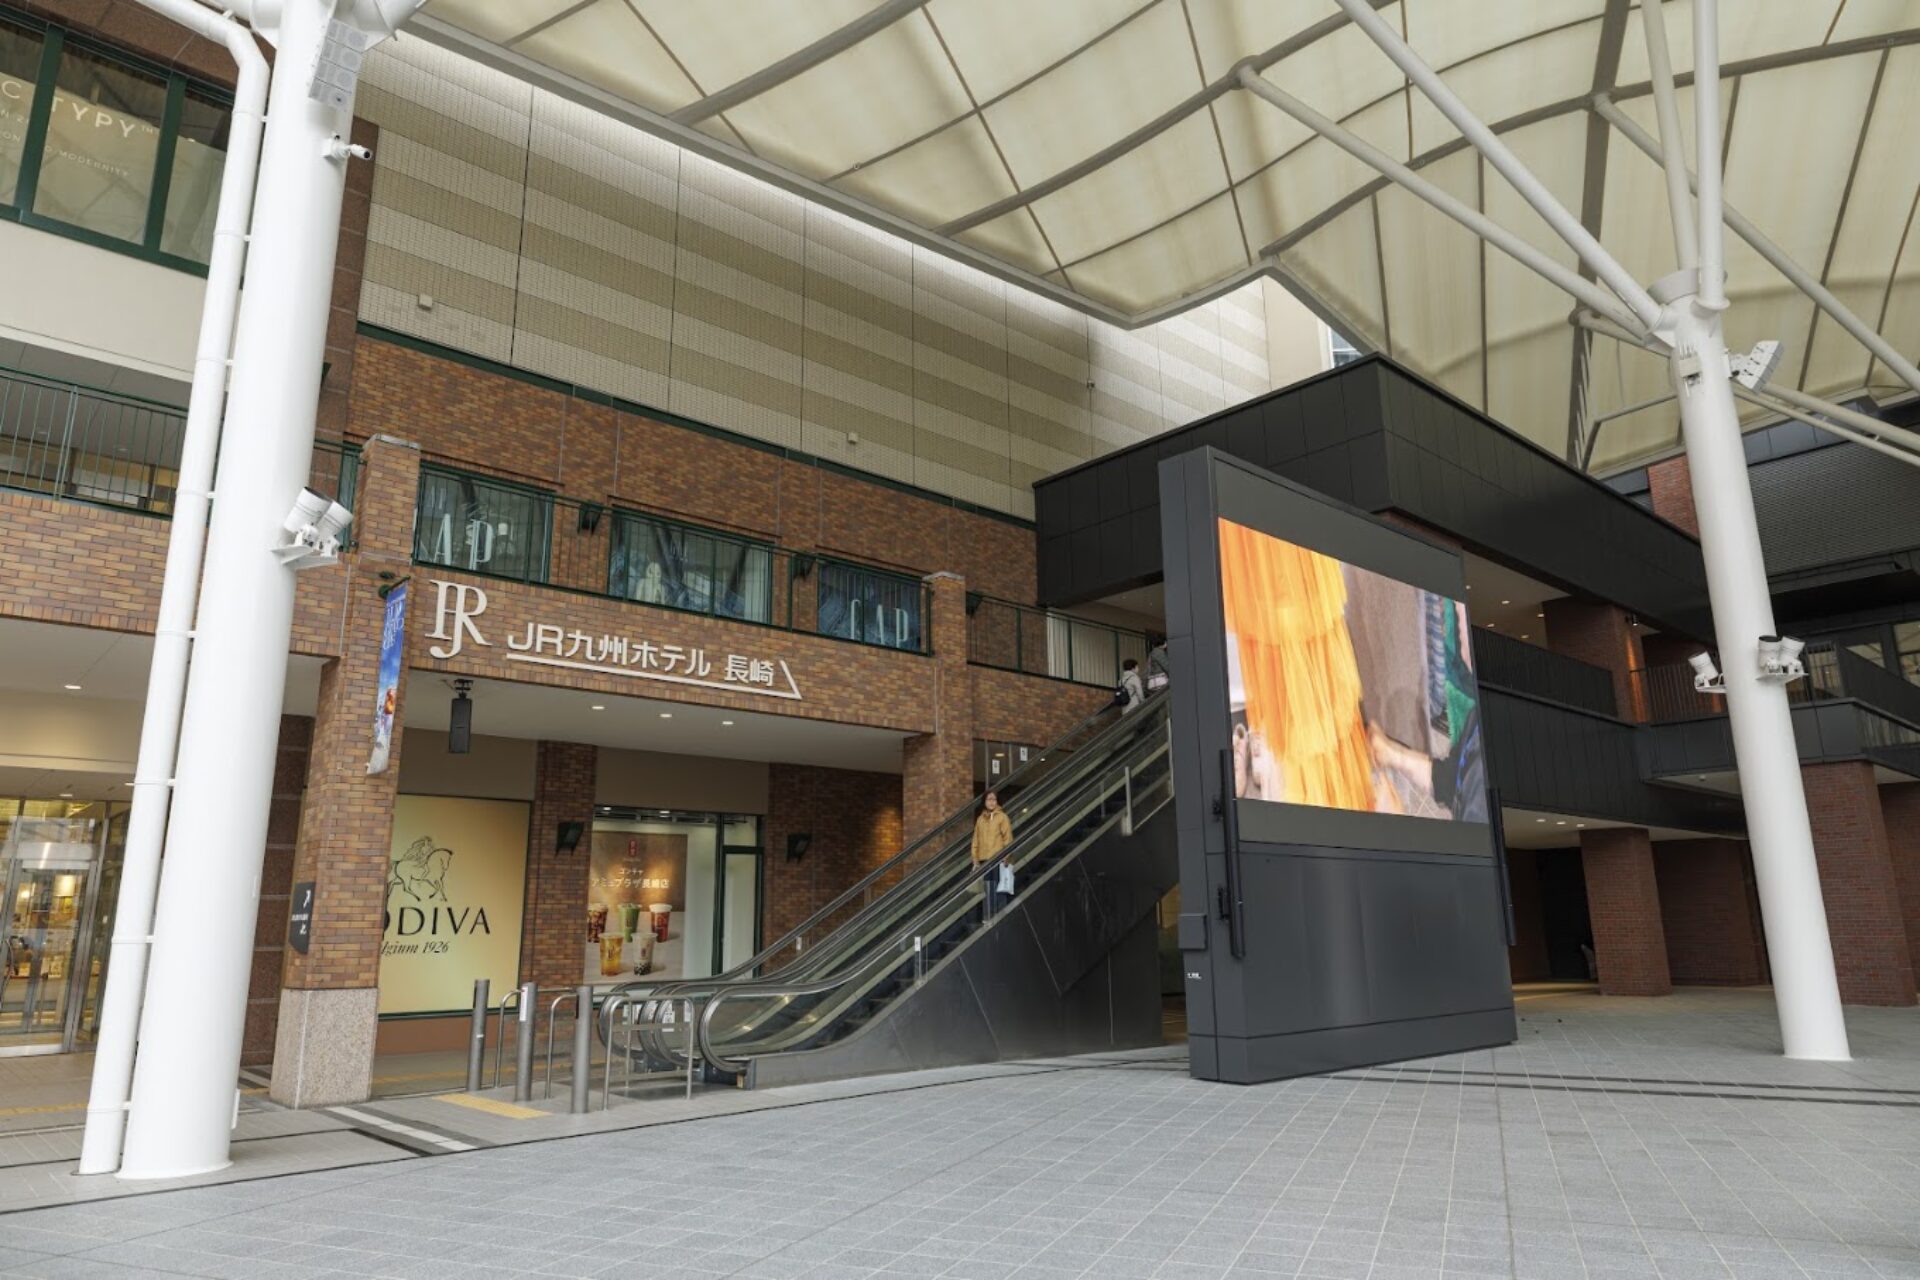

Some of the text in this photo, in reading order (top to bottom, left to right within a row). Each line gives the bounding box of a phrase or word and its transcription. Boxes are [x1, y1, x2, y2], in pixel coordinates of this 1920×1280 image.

[433, 512, 494, 570] AP
[507, 621, 775, 687] JR九州ホテル 長崎
[384, 906, 491, 936] DIVA
[381, 940, 450, 956] lgium 1926
